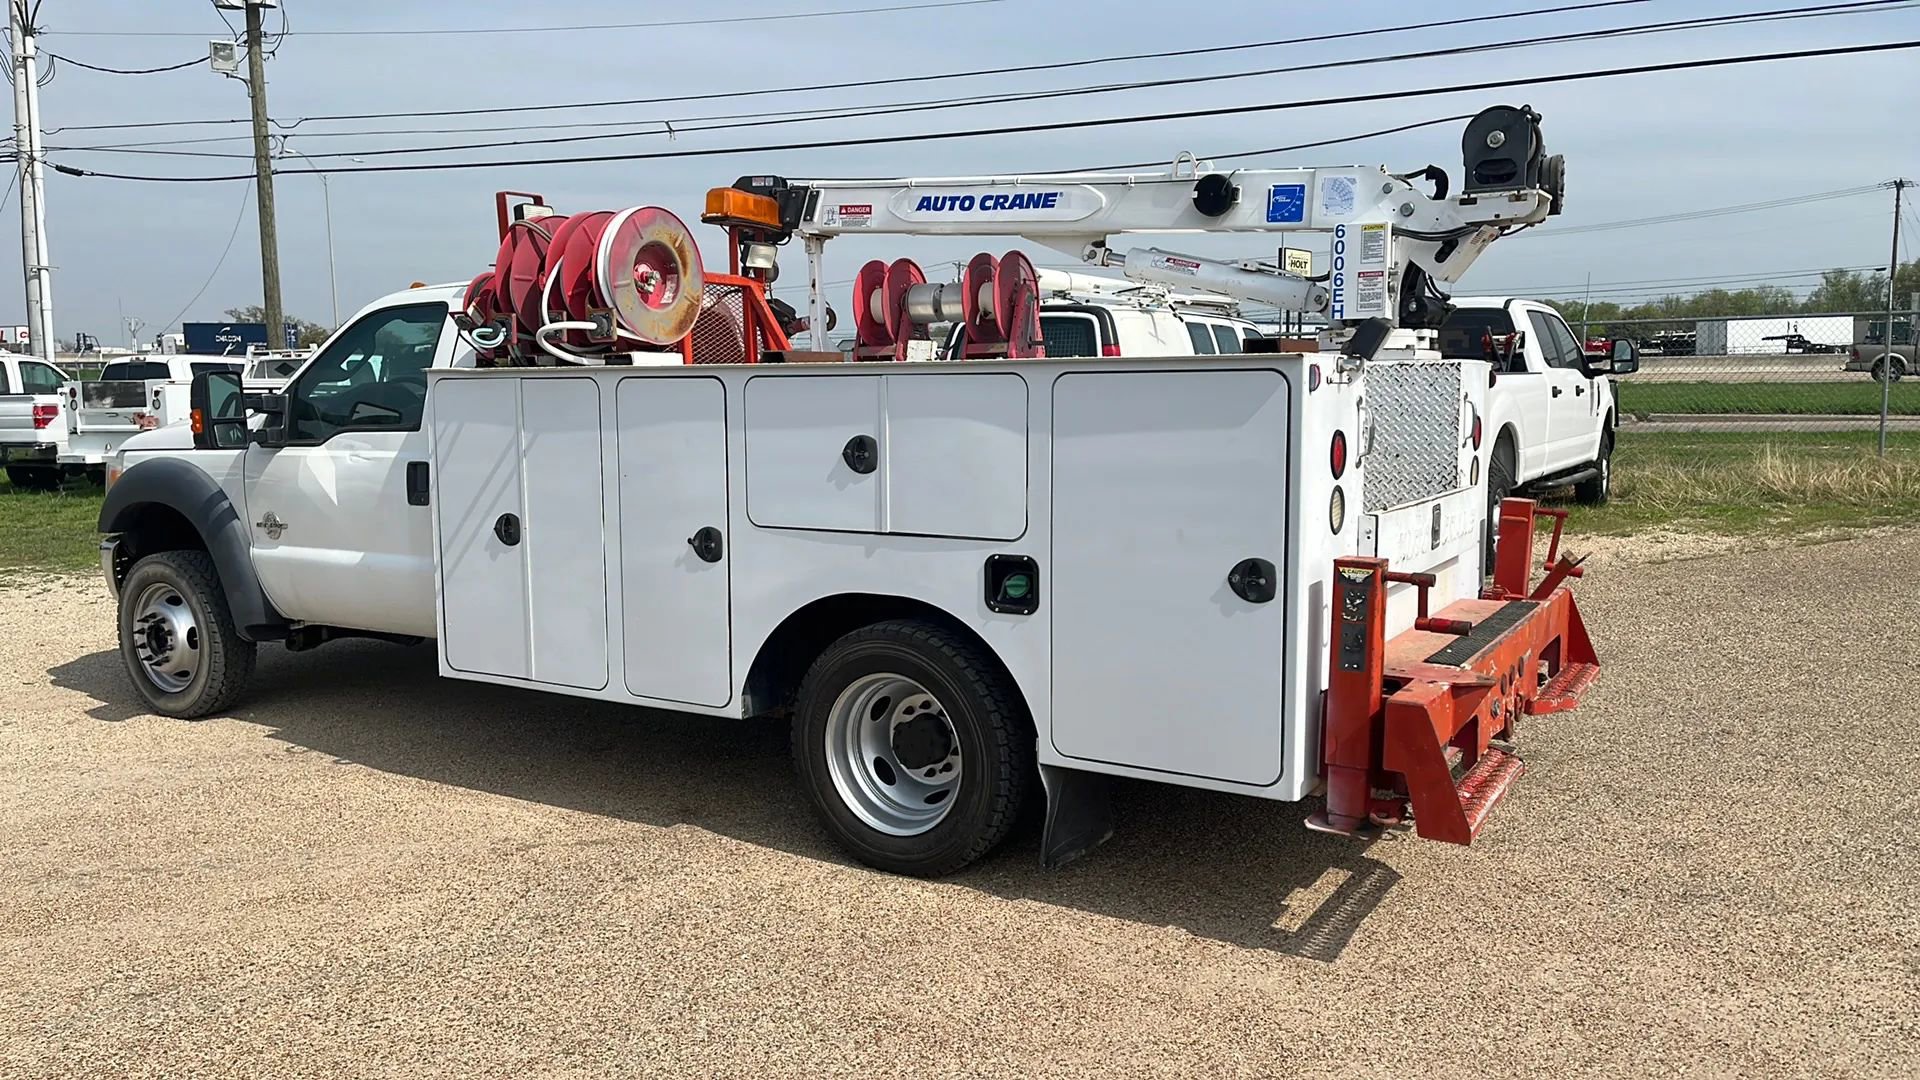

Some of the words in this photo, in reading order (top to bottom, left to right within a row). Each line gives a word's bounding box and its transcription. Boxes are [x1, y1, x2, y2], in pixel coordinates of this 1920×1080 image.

[915, 195, 975, 211] AUTO
[979, 192, 1058, 211] CRANE
[1290, 259, 1308, 269] HOLT
[1332, 224, 1345, 319] 6006EH
